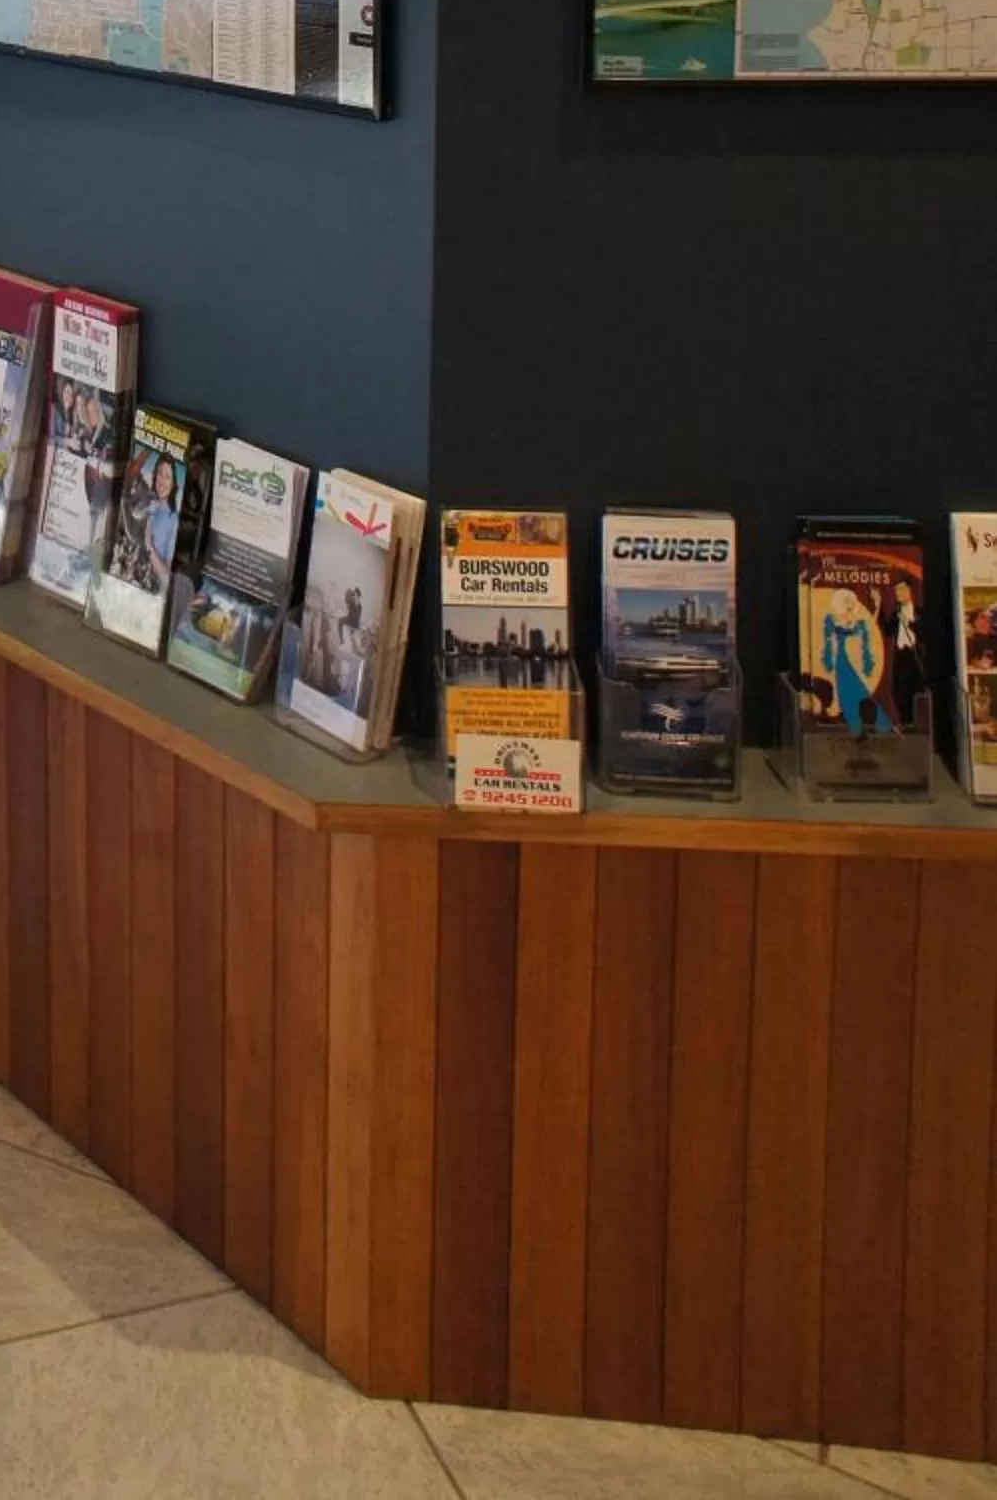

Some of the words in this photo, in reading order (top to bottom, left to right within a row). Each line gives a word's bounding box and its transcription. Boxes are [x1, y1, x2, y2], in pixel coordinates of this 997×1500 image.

[612, 536, 730, 563] CRUISES
[459, 559, 550, 577] BURSWOOD
[460, 576, 487, 593] Car
[491, 577, 548, 593] Rentals
[824, 571, 892, 585] MELODIES
[474, 777, 500, 789] CAR
[503, 779, 561, 792] RENTALS
[481, 791, 528, 805] 9245
